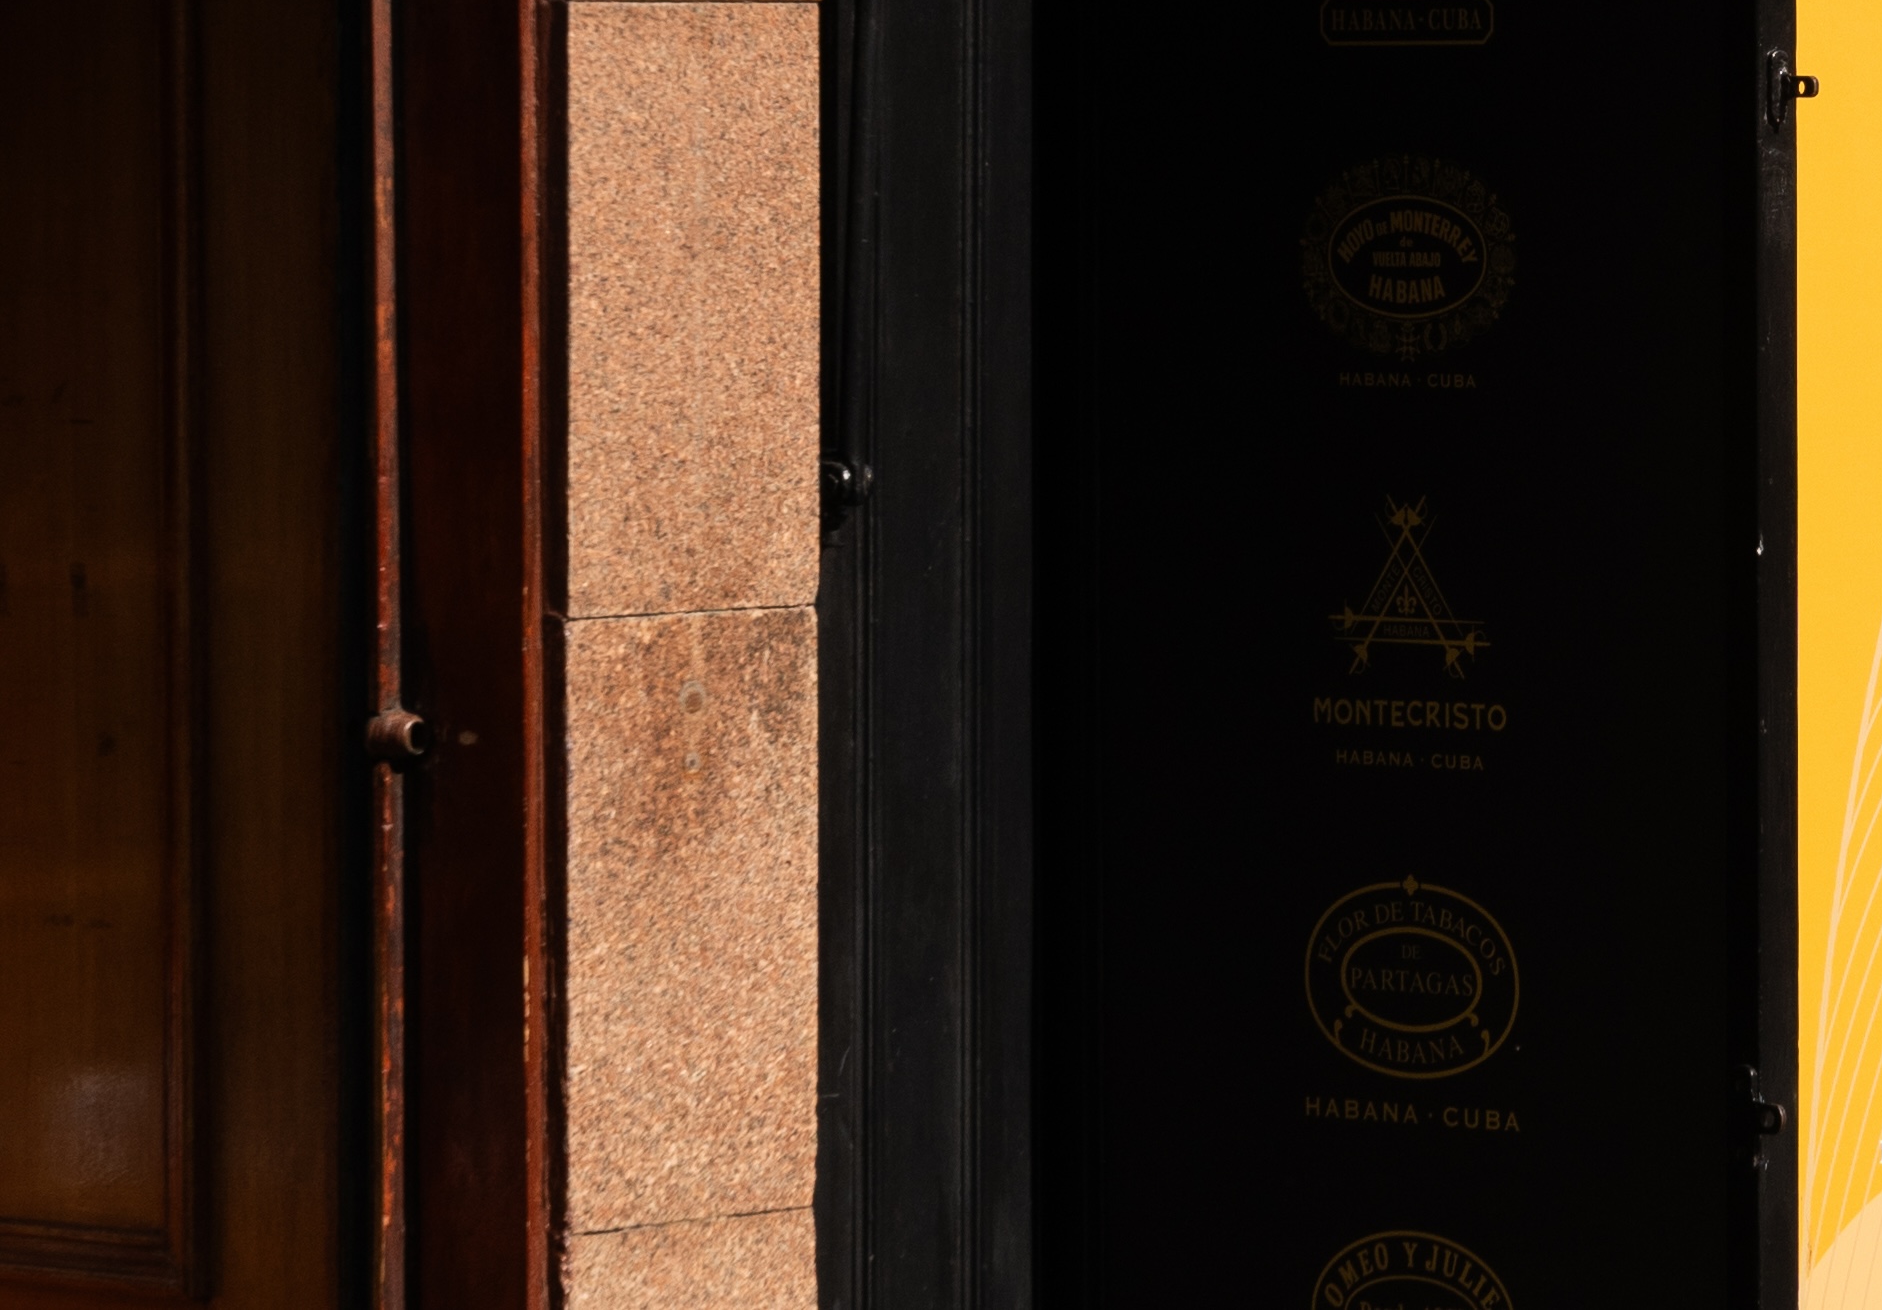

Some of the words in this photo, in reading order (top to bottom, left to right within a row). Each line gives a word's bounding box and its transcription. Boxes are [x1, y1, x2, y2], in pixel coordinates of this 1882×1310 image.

[1336, 219, 1375, 264] HOYO
[1389, 210, 1479, 264] MONTERREY
[1372, 251, 1407, 268] VUELTA
[1408, 252, 1442, 268] ABAJO
[1368, 274, 1447, 304] HABANA
[1337, 371, 1411, 388] HABANA
[1427, 372, 1477, 389] CUBA
[1383, 624, 1431, 638] HABANA
[1313, 697, 1507, 732] MONTECRISTO
[1335, 749, 1415, 768] HABANA
[1430, 753, 1485, 772] CUBA
[1316, 908, 1369, 966] FLOR
[1374, 900, 1405, 924] DE
[1410, 900, 1507, 978] TABACOS
[1400, 944, 1422, 961] DE
[1349, 967, 1475, 998] PARTAGAS
[1358, 1026, 1465, 1066] HABANA
[1304, 1096, 1420, 1125] HABANA
[1441, 1106, 1521, 1133] CUBA
[1324, 1241, 1390, 1308] OMEO
[1424, 1243, 1501, 1310] JULIE
